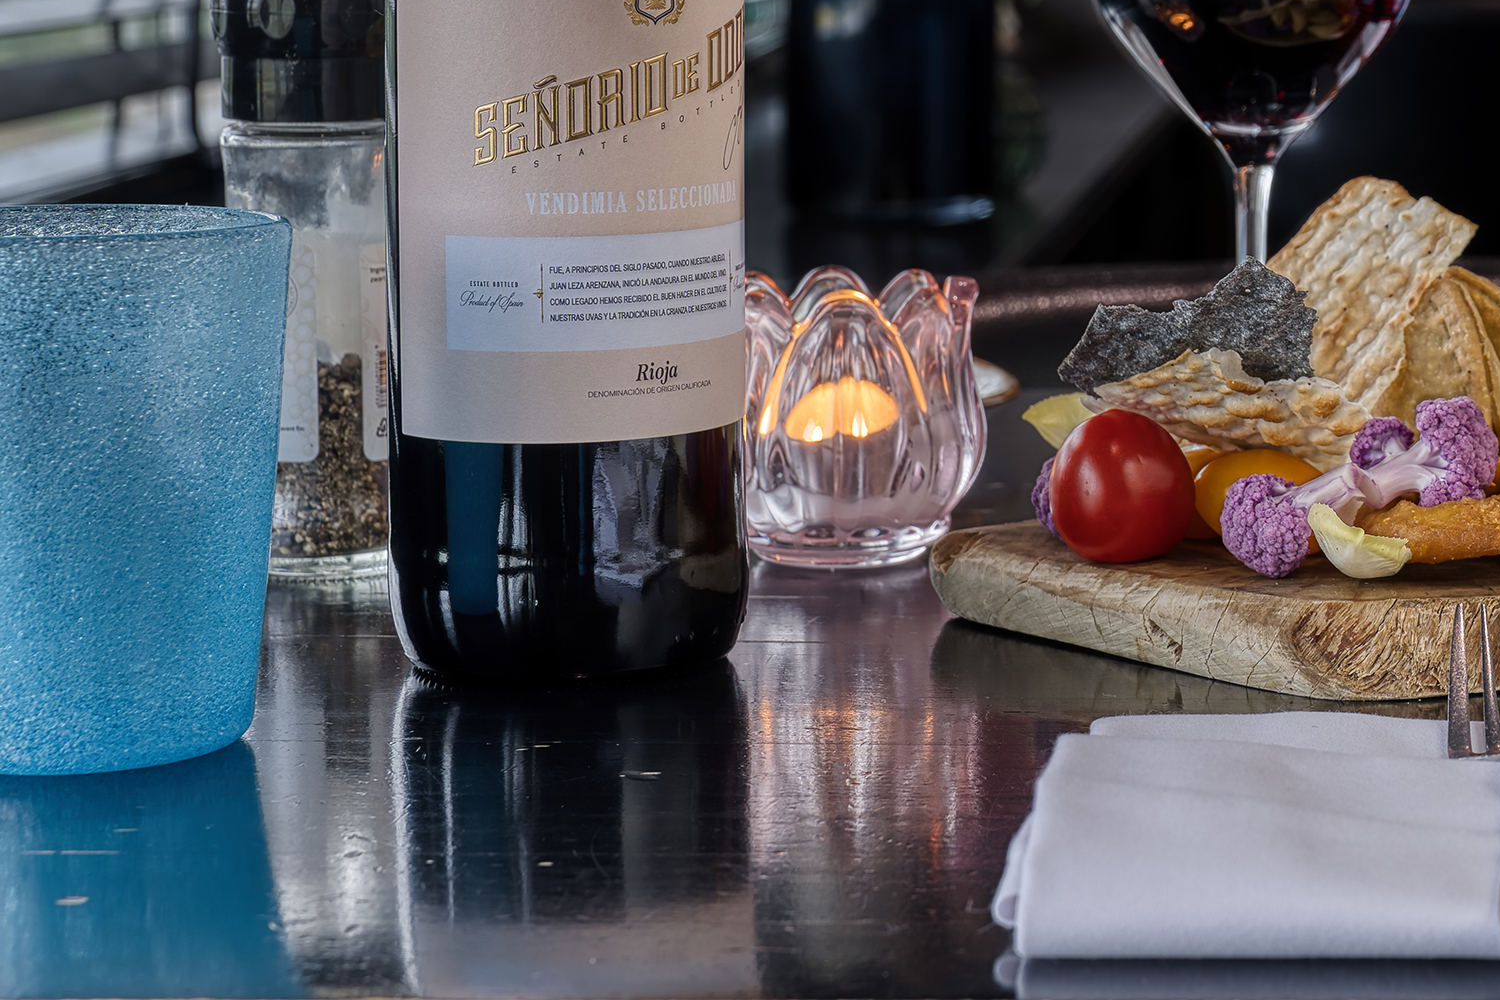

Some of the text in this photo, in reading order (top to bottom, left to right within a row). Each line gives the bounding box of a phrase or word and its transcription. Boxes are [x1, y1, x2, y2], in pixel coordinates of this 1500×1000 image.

[473, 52, 668, 167] SEÑORIO
[672, 52, 700, 101] DE
[512, 134, 628, 174] ESTATE
[525, 180, 737, 215] VENDIMIA SELECCIONADA
[549, 266, 564, 274] FUE,
[565, 266, 570, 274] A
[572, 265, 608, 274] PRINCIPIOS
[610, 264, 622, 272] DEL
[623, 263, 641, 272] SIGLO
[668, 259, 689, 268] CUANDO
[690, 256, 710, 266] NUESTRO
[549, 282, 566, 290] JUAN
[586, 280, 621, 289] ARENZANA,
[623, 278, 641, 287] INICIÓ
[650, 276, 679, 285] ANDADURA
[681, 275, 687, 283] EN
[688, 274, 694, 282] EL
[695, 272, 710, 281] MUNDO
[460, 290, 491, 306] Product
[499, 292, 524, 313] Spain
[550, 298, 570, 306] COMO
[572, 297, 598, 305] LEGADO
[600, 296, 622, 304] HEMOS
[624, 294, 652, 303] RECIBIDO
[661, 292, 676, 300] BUEN
[677, 290, 693, 299] HACER
[701, 288, 706, 296] EL
[550, 314, 584, 322] NUESTRAS
[586, 313, 602, 321] UVAS
[609, 312, 617, 320] LA
[618, 309, 650, 319] TRADICIÓN
[650, 309, 658, 317] EN
[666, 306, 687, 315] CRIANZA
[688, 305, 694, 313] DE
[695, 302, 716, 312] NUESTROS
[636, 360, 678, 384] Rioja
[588, 388, 645, 398] DENOMINACIÓN
[656, 384, 680, 393] ORIGEN
[681, 379, 712, 390] CALIFICADA
